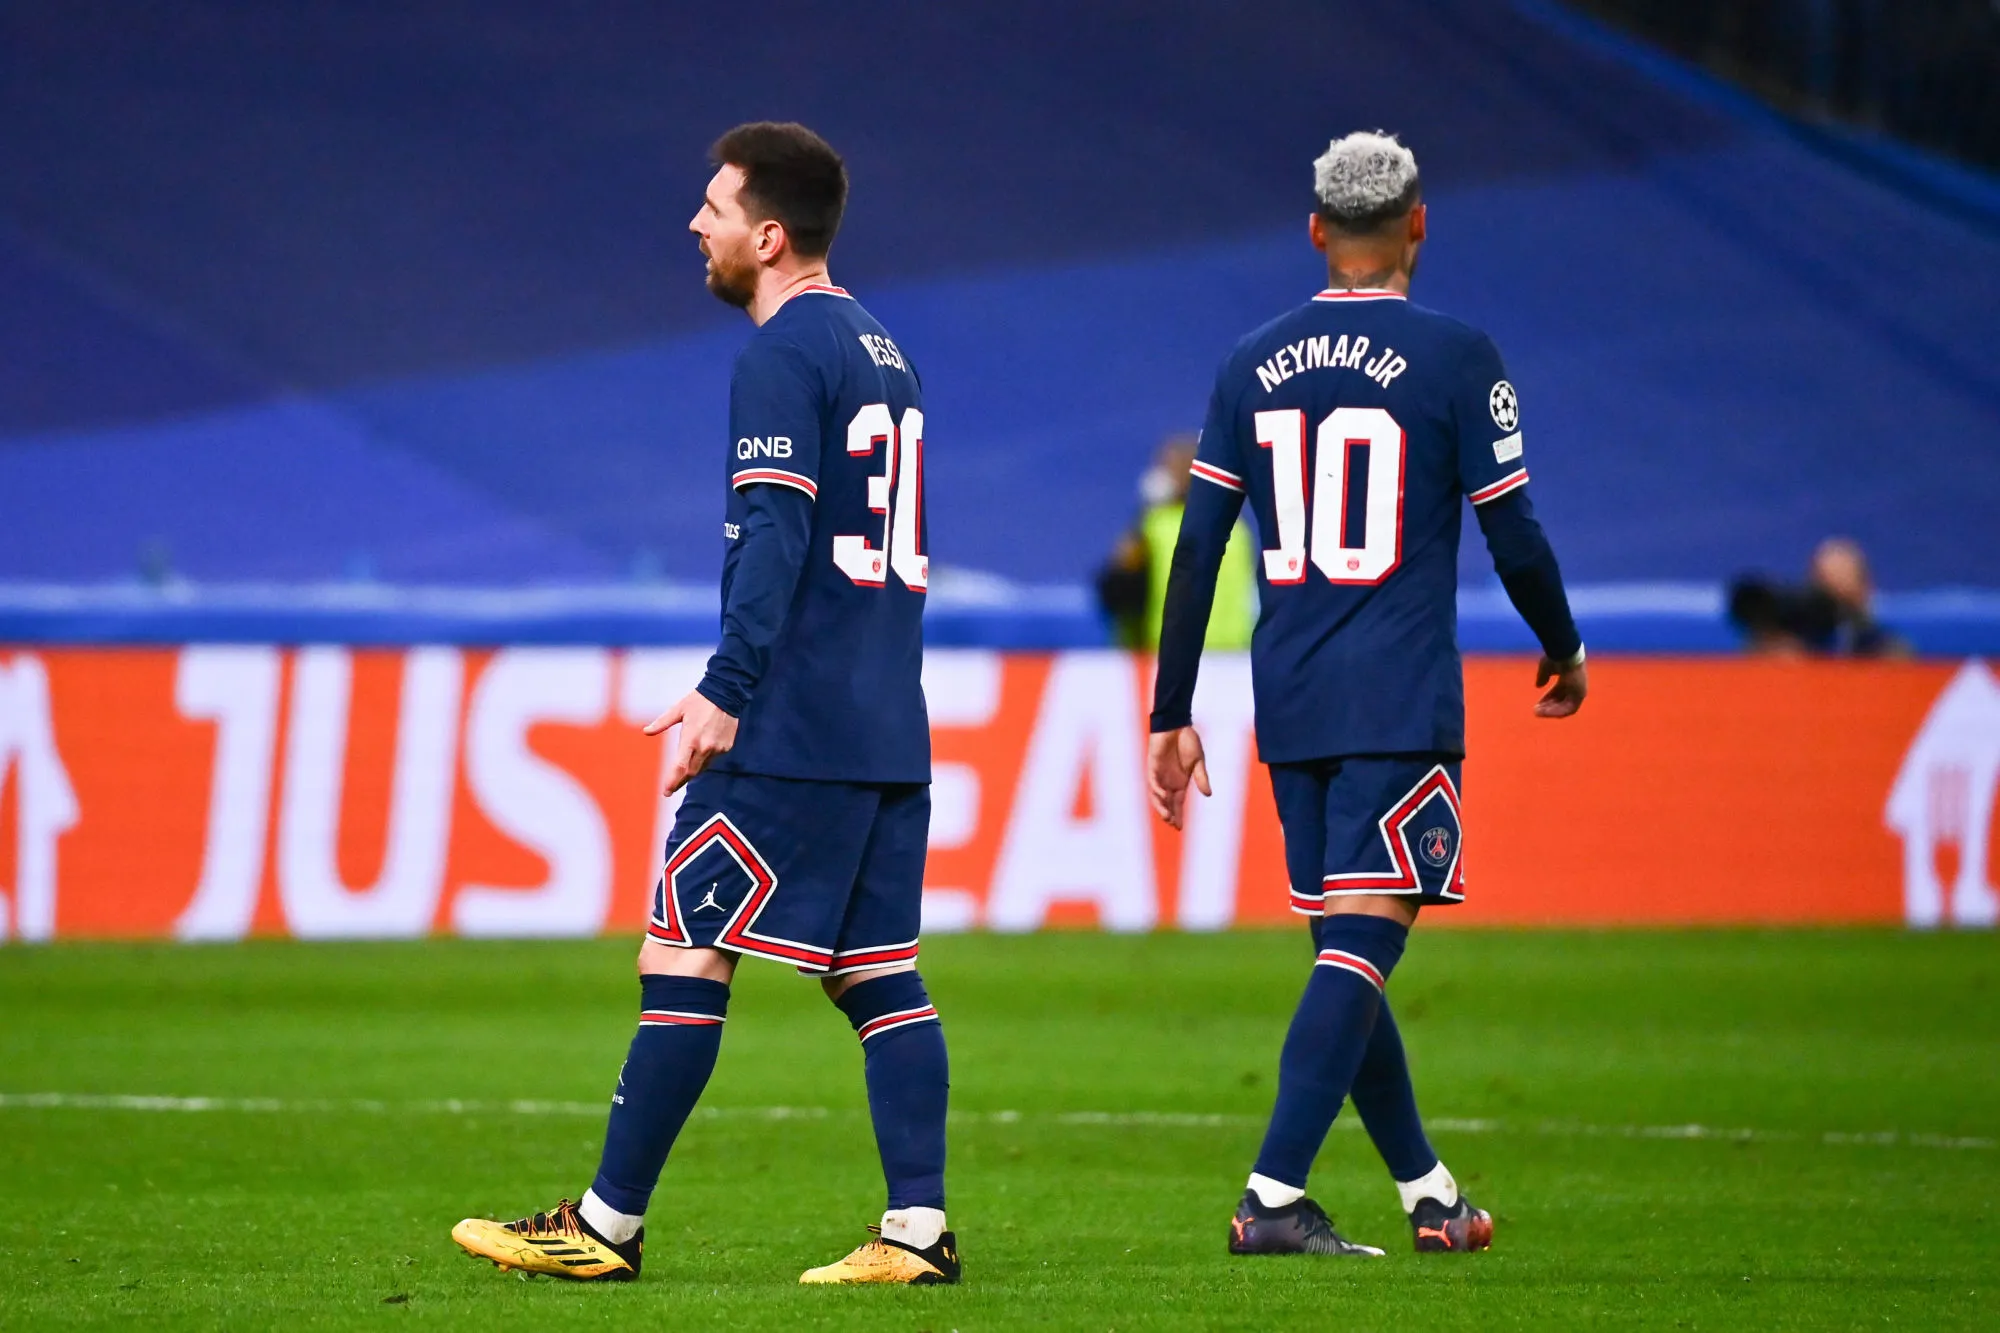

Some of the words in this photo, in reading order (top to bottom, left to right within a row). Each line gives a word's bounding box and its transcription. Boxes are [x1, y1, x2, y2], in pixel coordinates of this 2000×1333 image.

[858, 333, 906, 373] MESSI
[1255, 334, 1370, 393] NEYMAR
[1364, 347, 1407, 389] JR
[737, 436, 793, 460] QNB
[833, 404, 929, 592] 30
[1254, 407, 1407, 585] 10
[587, 1246, 597, 1254] 10
